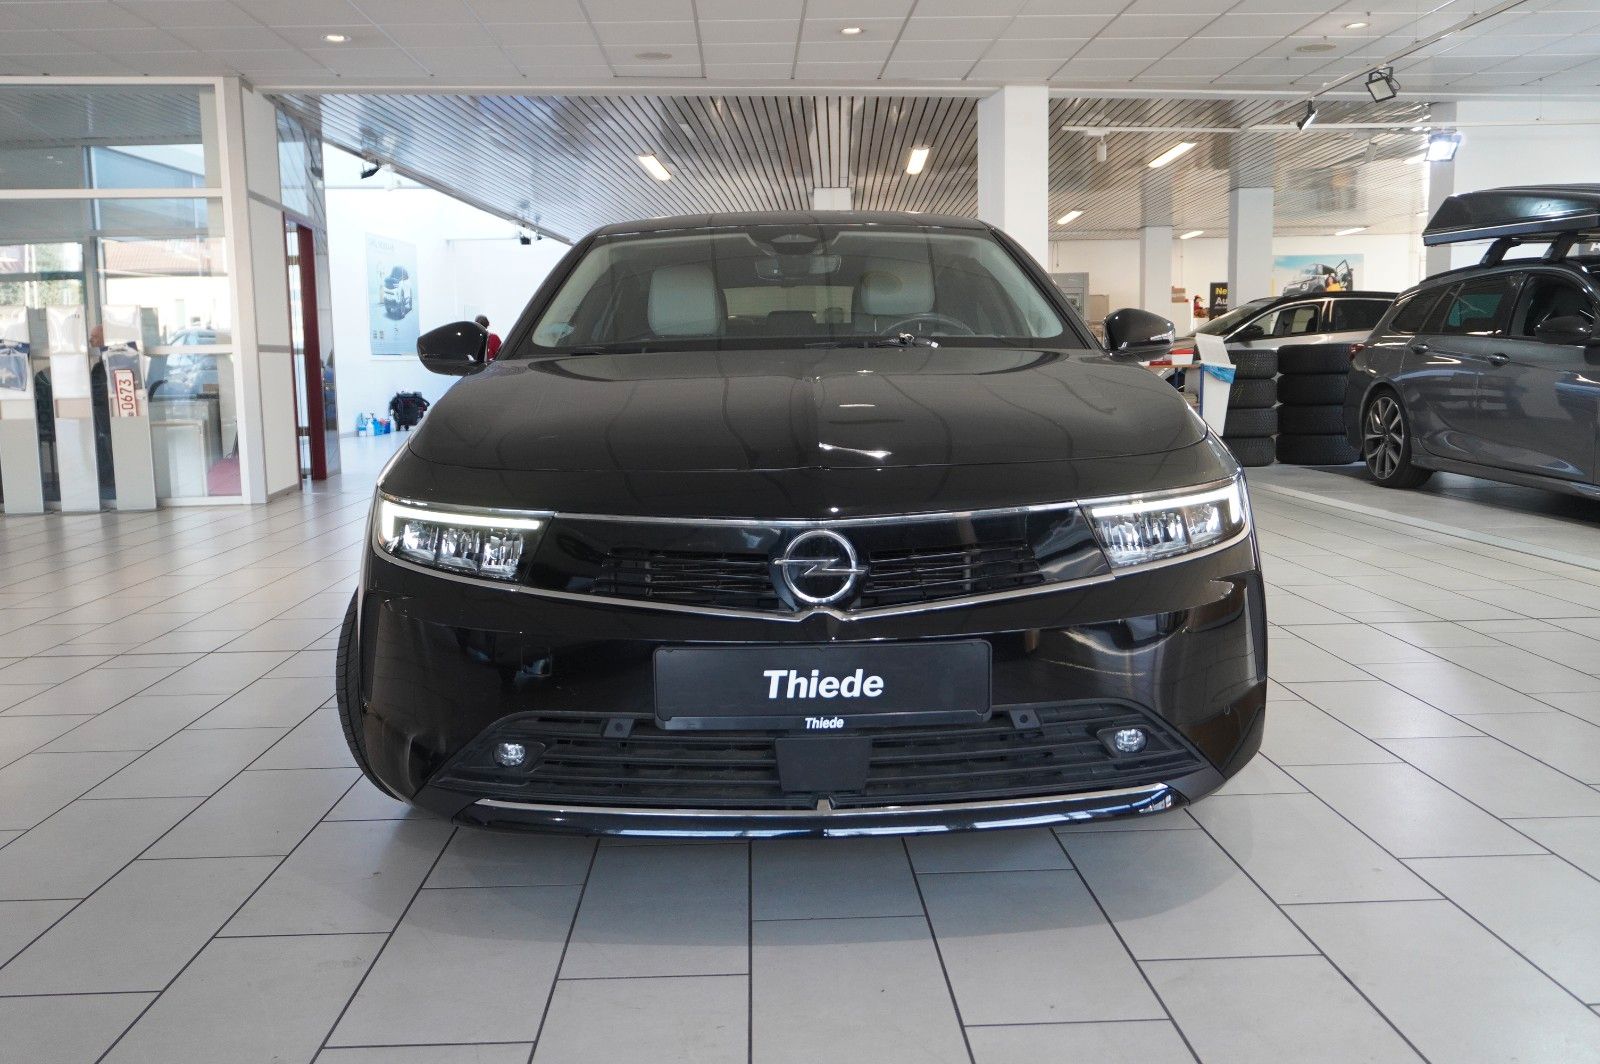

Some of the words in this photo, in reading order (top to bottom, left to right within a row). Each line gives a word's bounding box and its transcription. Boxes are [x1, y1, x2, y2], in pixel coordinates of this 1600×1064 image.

[1215, 287, 1228, 295] Ne
[1215, 296, 1227, 305] Au
[119, 379, 134, 410] 0673
[763, 668, 884, 699] Thiede
[804, 716, 844, 729] Thiede
